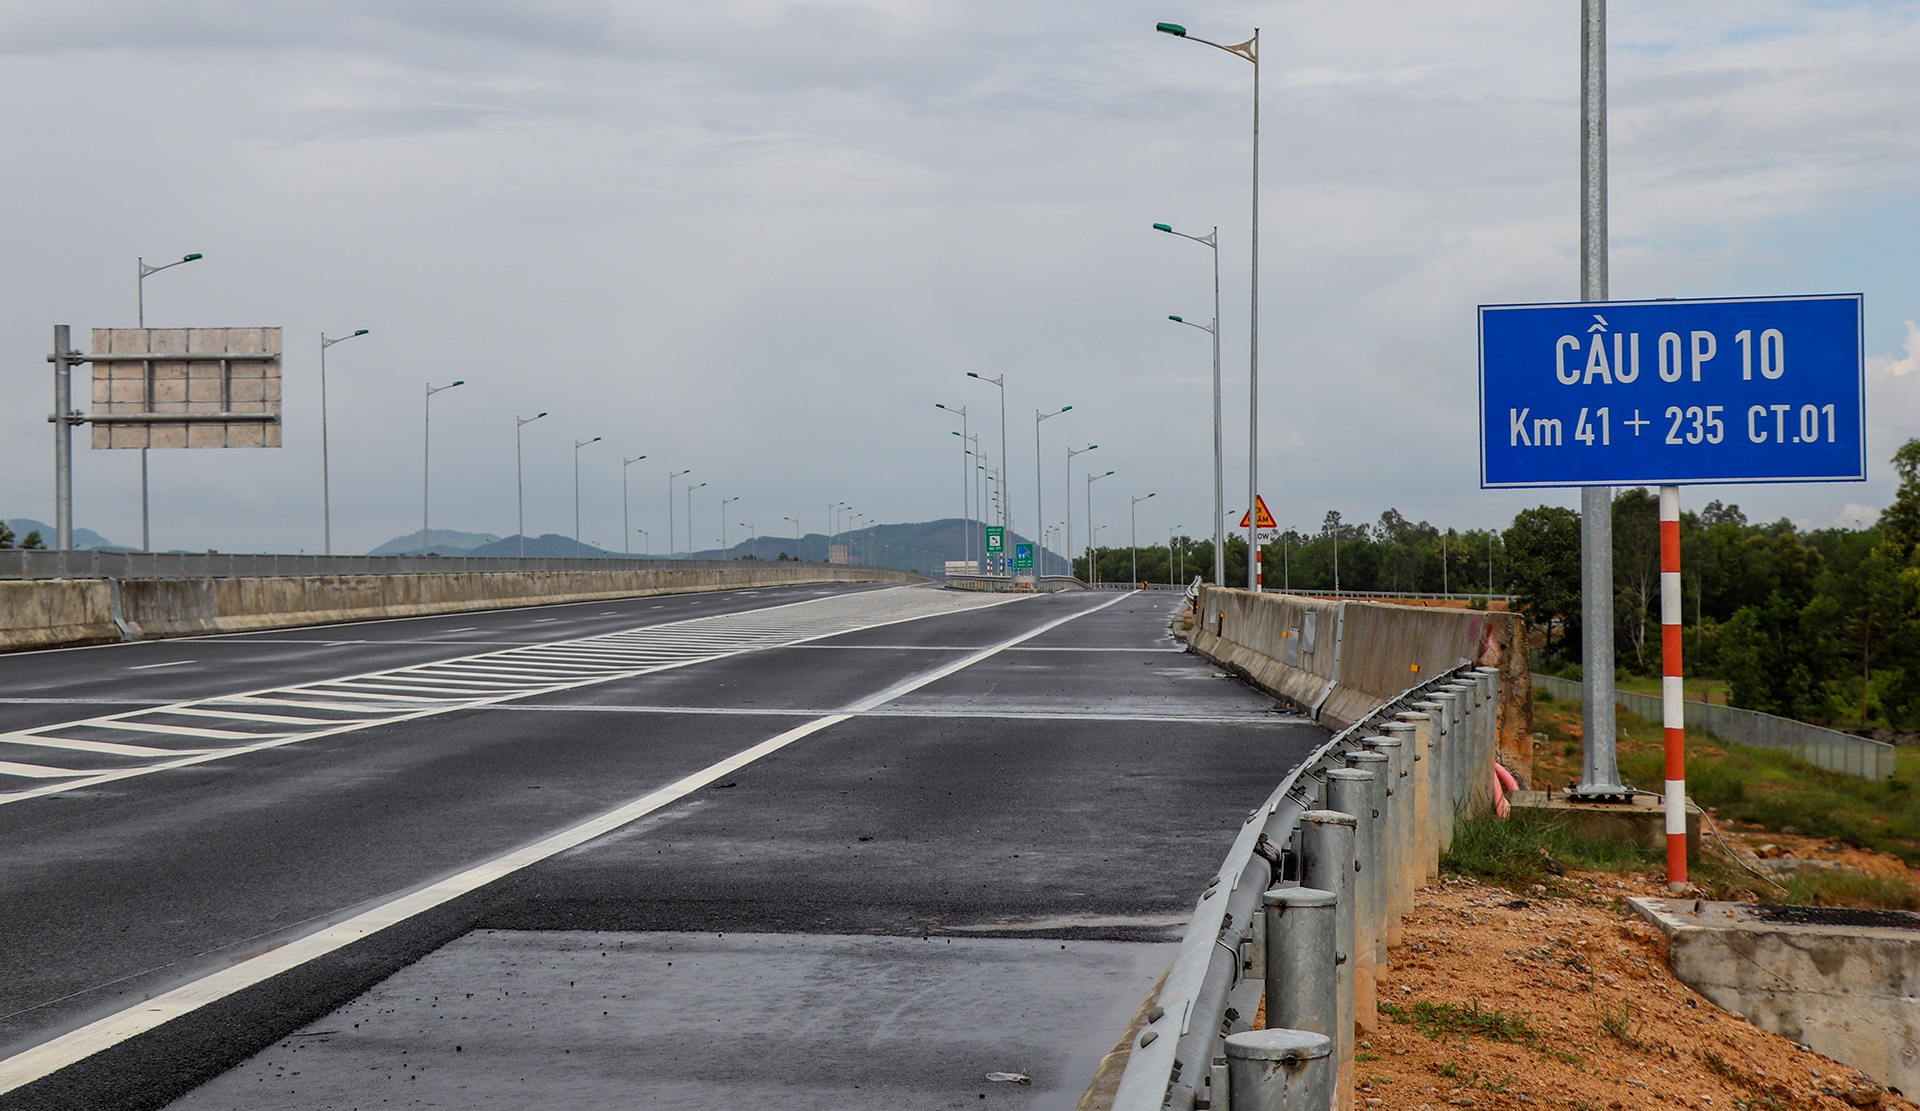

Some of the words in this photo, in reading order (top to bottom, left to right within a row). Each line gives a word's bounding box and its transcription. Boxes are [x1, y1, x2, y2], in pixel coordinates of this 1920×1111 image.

[1555, 314, 1639, 386] CẦU
[1658, 330, 1717, 383] OP
[1735, 328, 1785, 381] 10
[1510, 407, 1562, 447] Km
[1574, 406, 1610, 446] 41
[1623, 409, 1651, 437] +
[1665, 404, 1724, 445] 235
[1747, 403, 1835, 444] CT.01
